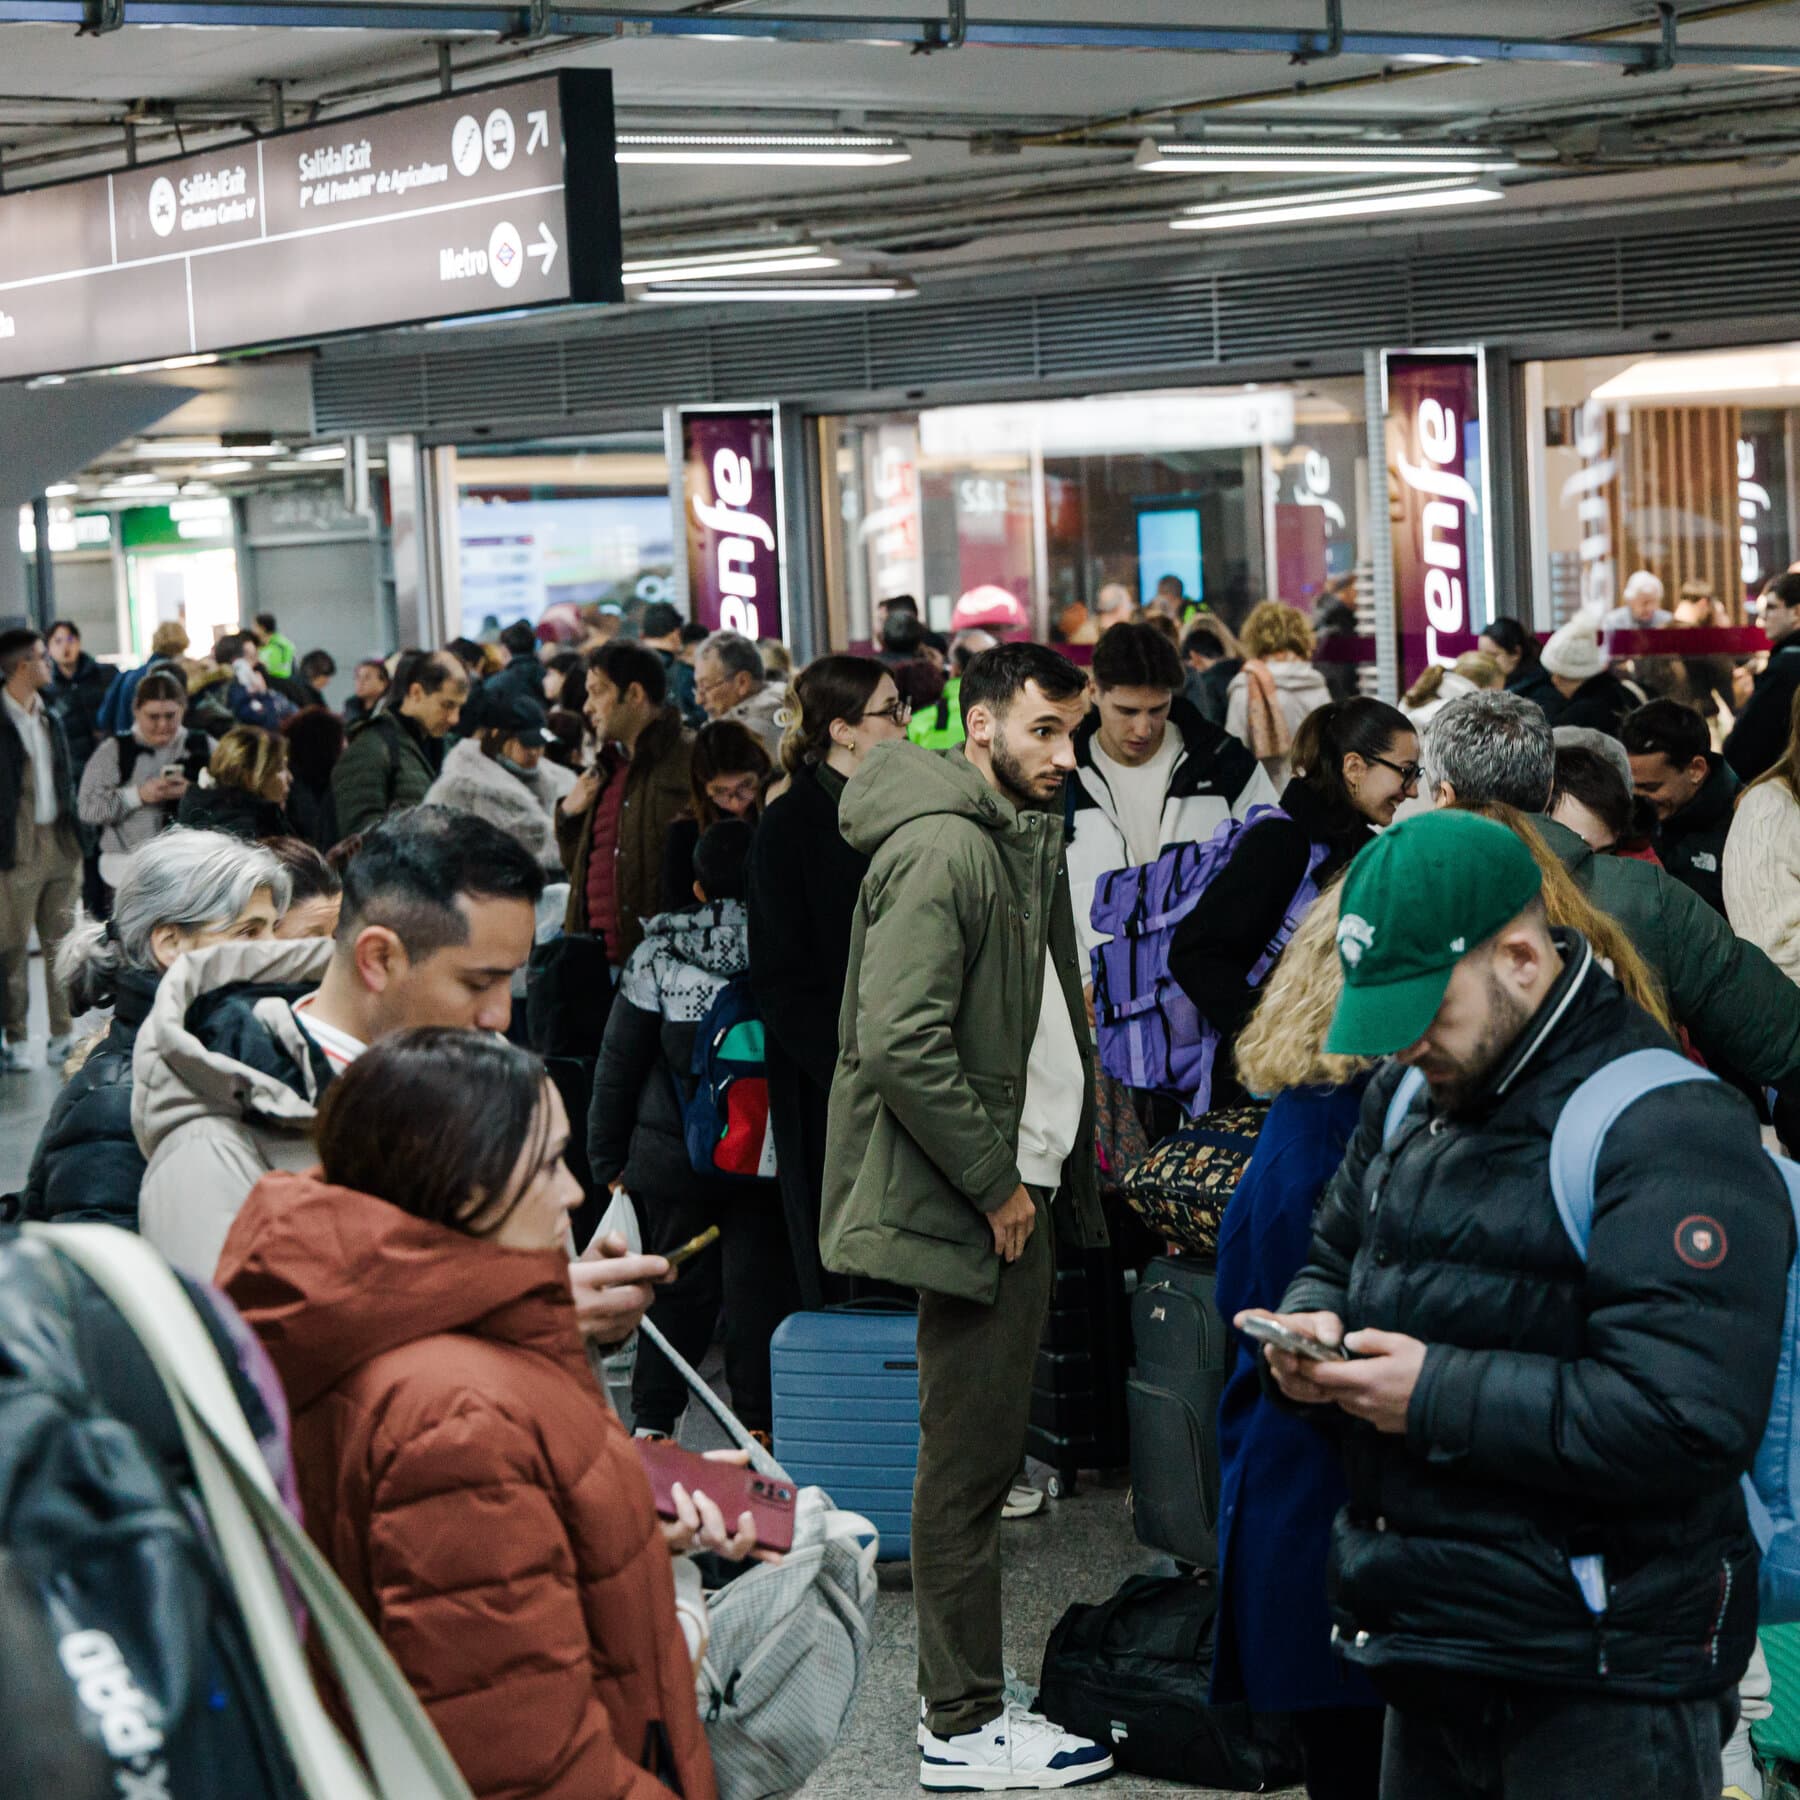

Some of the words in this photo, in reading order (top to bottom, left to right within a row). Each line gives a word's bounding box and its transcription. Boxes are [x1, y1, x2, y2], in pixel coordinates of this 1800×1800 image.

[439, 247, 489, 280] Metro
[692, 447, 776, 641] enfe
[1396, 397, 1478, 669] renfe
